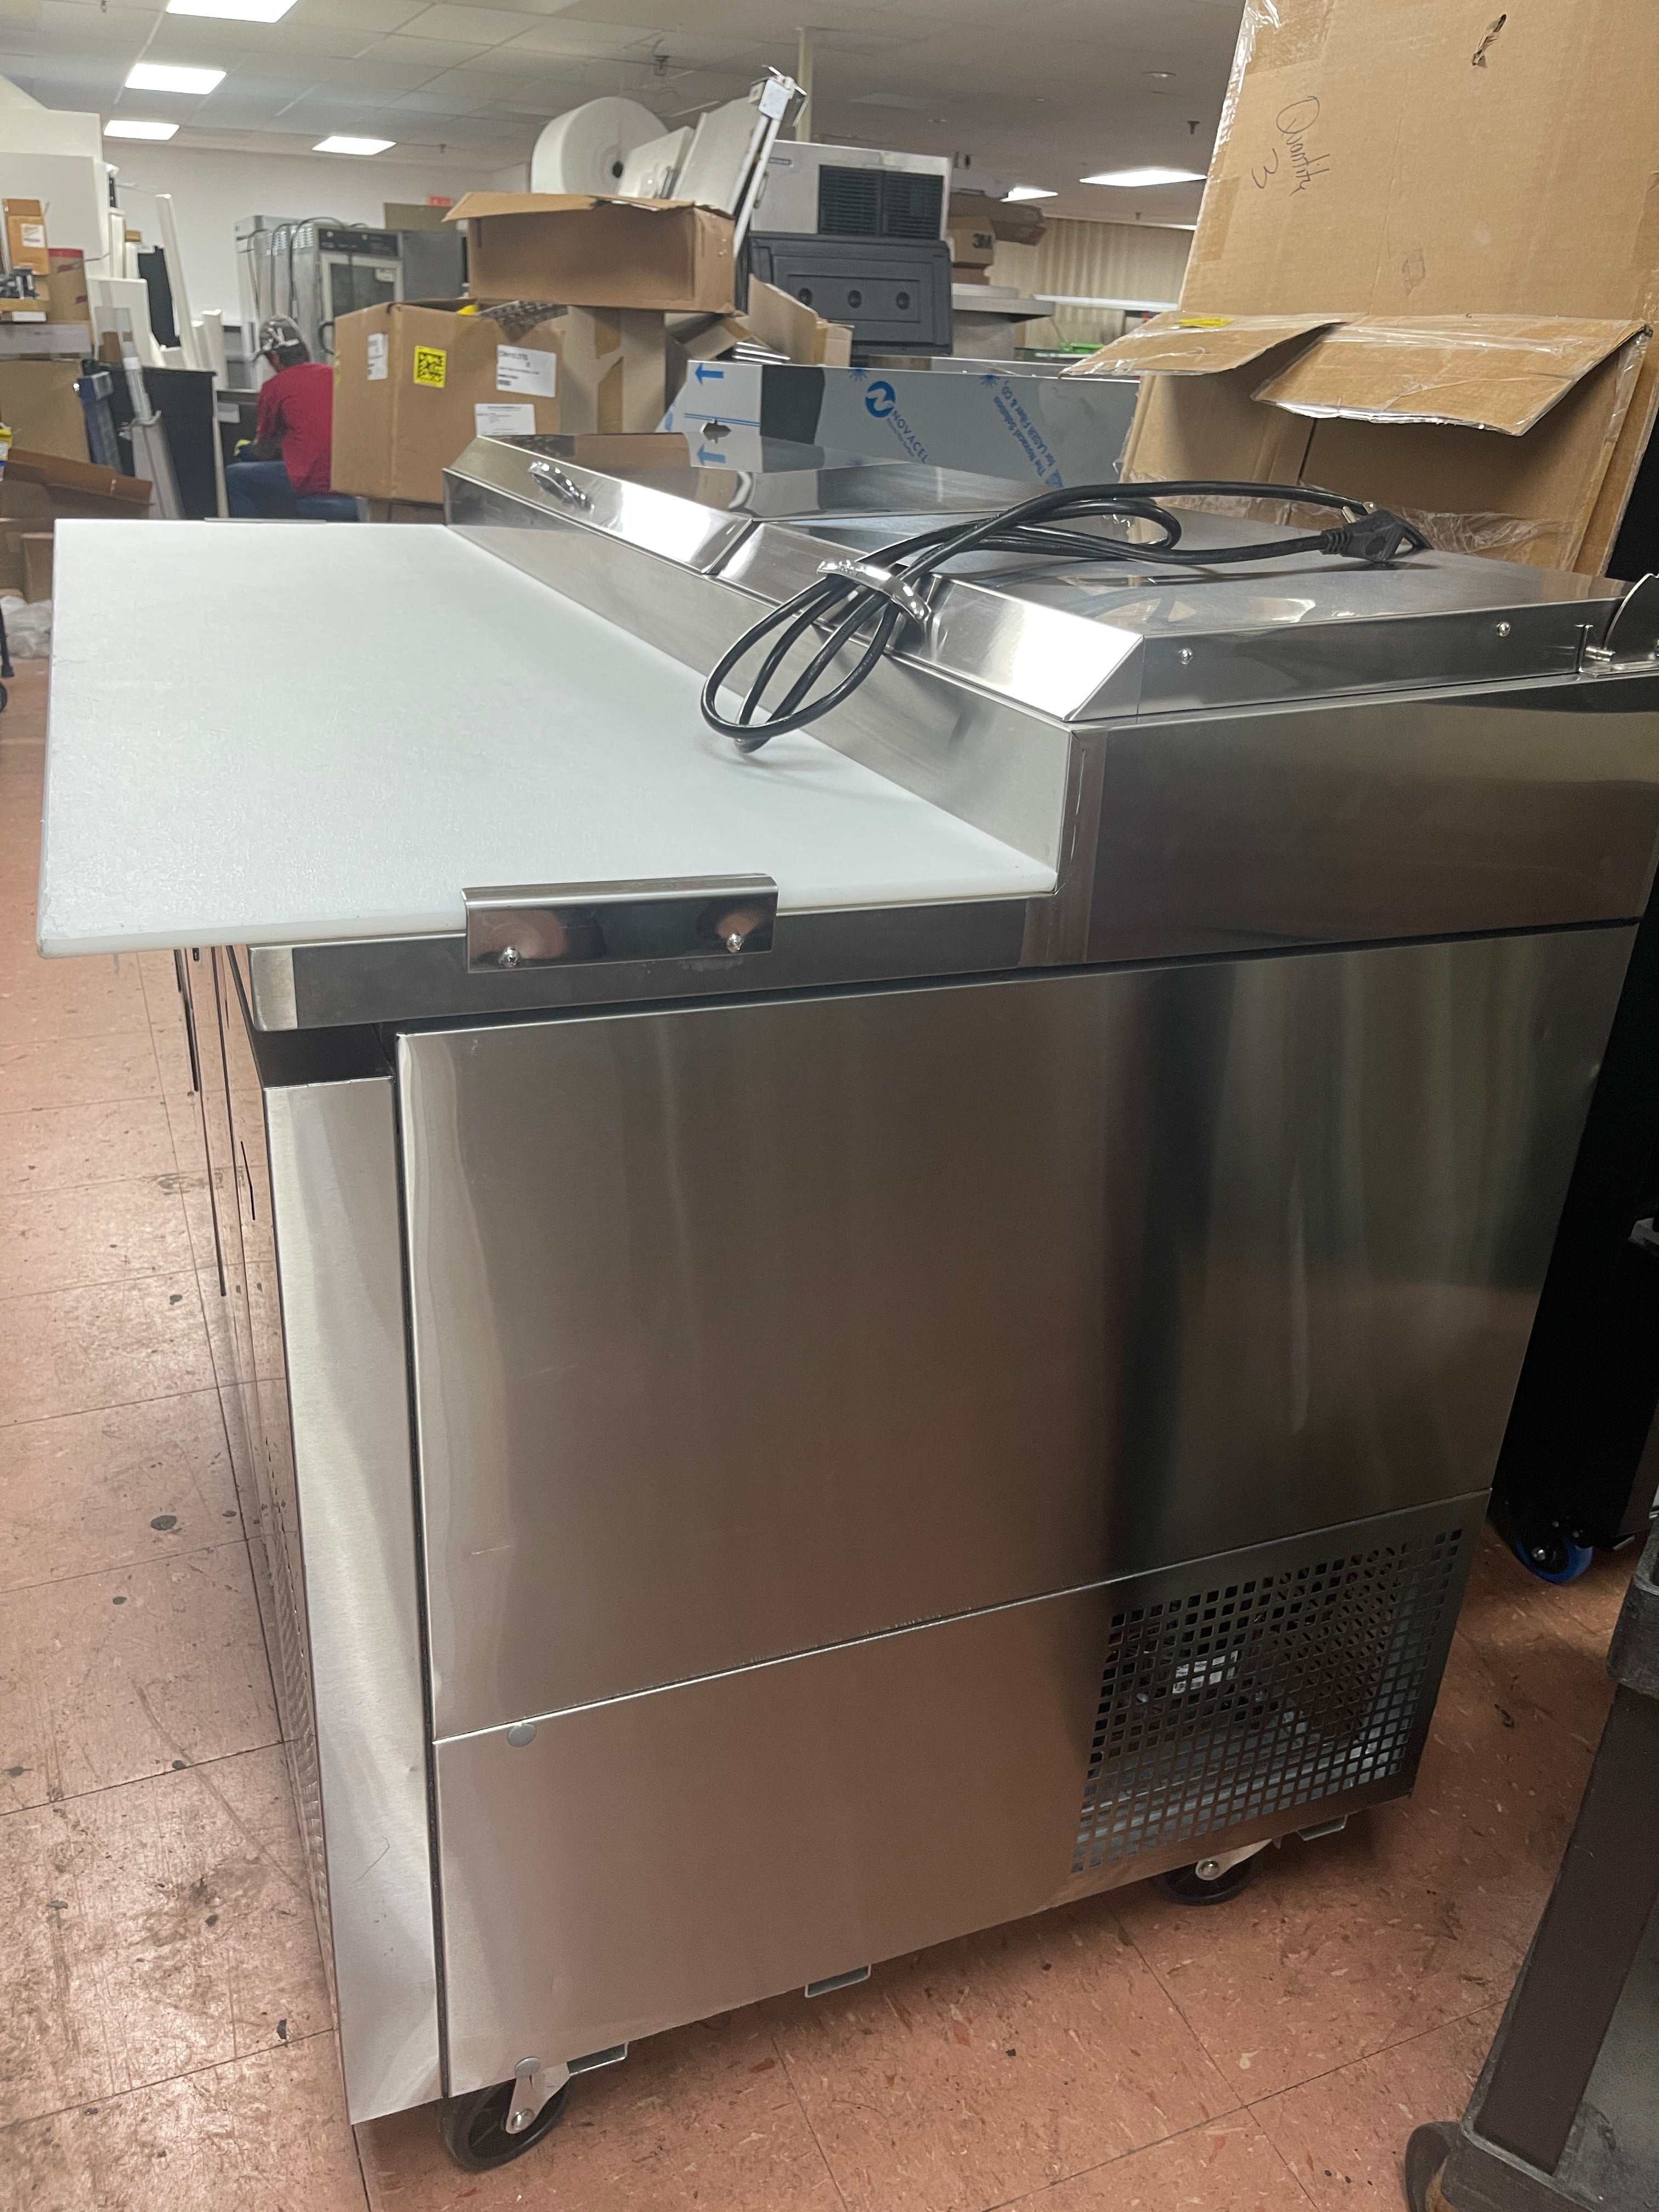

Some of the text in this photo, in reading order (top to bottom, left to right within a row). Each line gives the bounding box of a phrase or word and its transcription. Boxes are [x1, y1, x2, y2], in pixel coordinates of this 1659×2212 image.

[1251, 148, 1279, 189] 3
[1276, 95, 1330, 196] Quantity
[890, 410, 928, 463] NOVACEL
